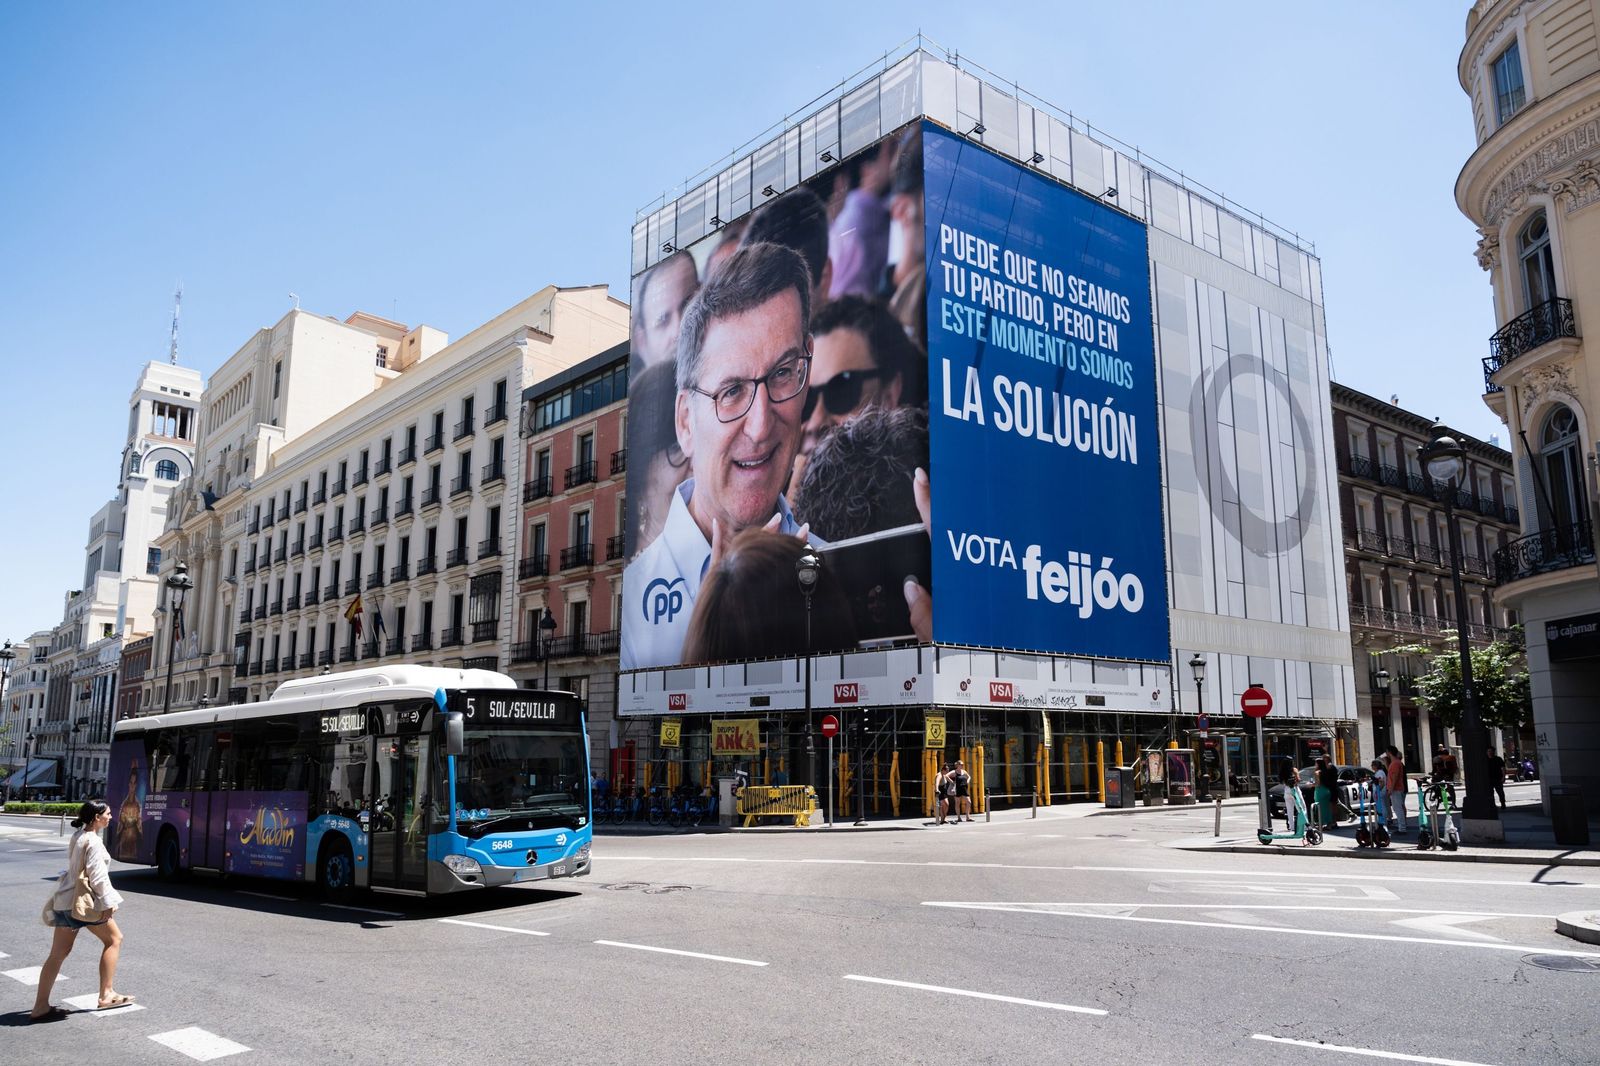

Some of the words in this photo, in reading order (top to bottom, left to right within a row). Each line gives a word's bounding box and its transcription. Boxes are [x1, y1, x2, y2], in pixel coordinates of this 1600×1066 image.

[941, 223, 1000, 275] PUEDE
[1003, 249, 1038, 290] QUE
[1042, 264, 1064, 299] NO
[1068, 275, 1131, 324] SEAMOS
[941, 260, 966, 298] TU
[971, 271, 1049, 331] PARTIDO,
[1053, 302, 1095, 343] PERO
[1098, 318, 1119, 352] EN
[941, 298, 987, 343] ESTE
[991, 316, 1077, 371] MOMENTO
[1080, 347, 1134, 390] SOMOS
[942, 357, 985, 426] LA
[993, 374, 1138, 465] SOLUCIÓN
[947, 529, 1018, 570] VOTA
[1022, 544, 1144, 619] feijóo
[1560, 623, 1597, 638] cajamar
[669, 695, 685, 706] VSA
[835, 685, 857, 698] VSA
[991, 684, 1012, 697] VSA
[466, 698, 475, 718] 5
[489, 700, 556, 719] SOL/SEVILLA
[321, 717, 329, 733] 5
[329, 713, 366, 733] SOL/SEVILLA
[240, 806, 294, 848] Aladdin
[492, 839, 513, 851] 5648
